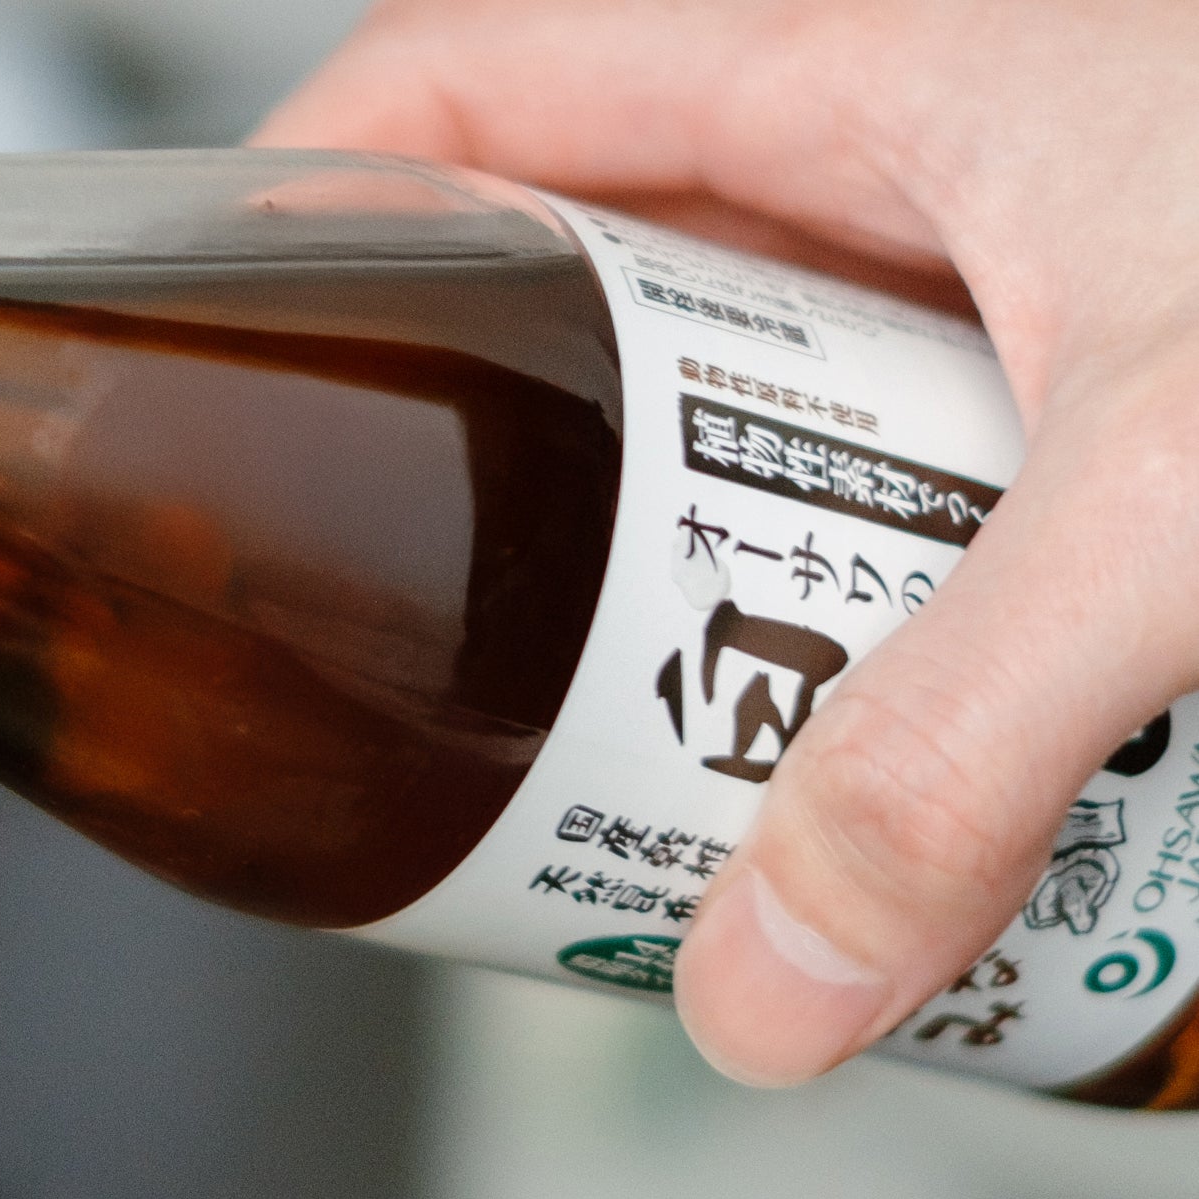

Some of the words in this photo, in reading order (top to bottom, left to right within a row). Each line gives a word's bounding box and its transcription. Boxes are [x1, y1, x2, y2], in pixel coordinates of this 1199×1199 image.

[677, 355, 880, 435] 動物性原料不使用
[1133, 742, 1199, 913] OHSAW
